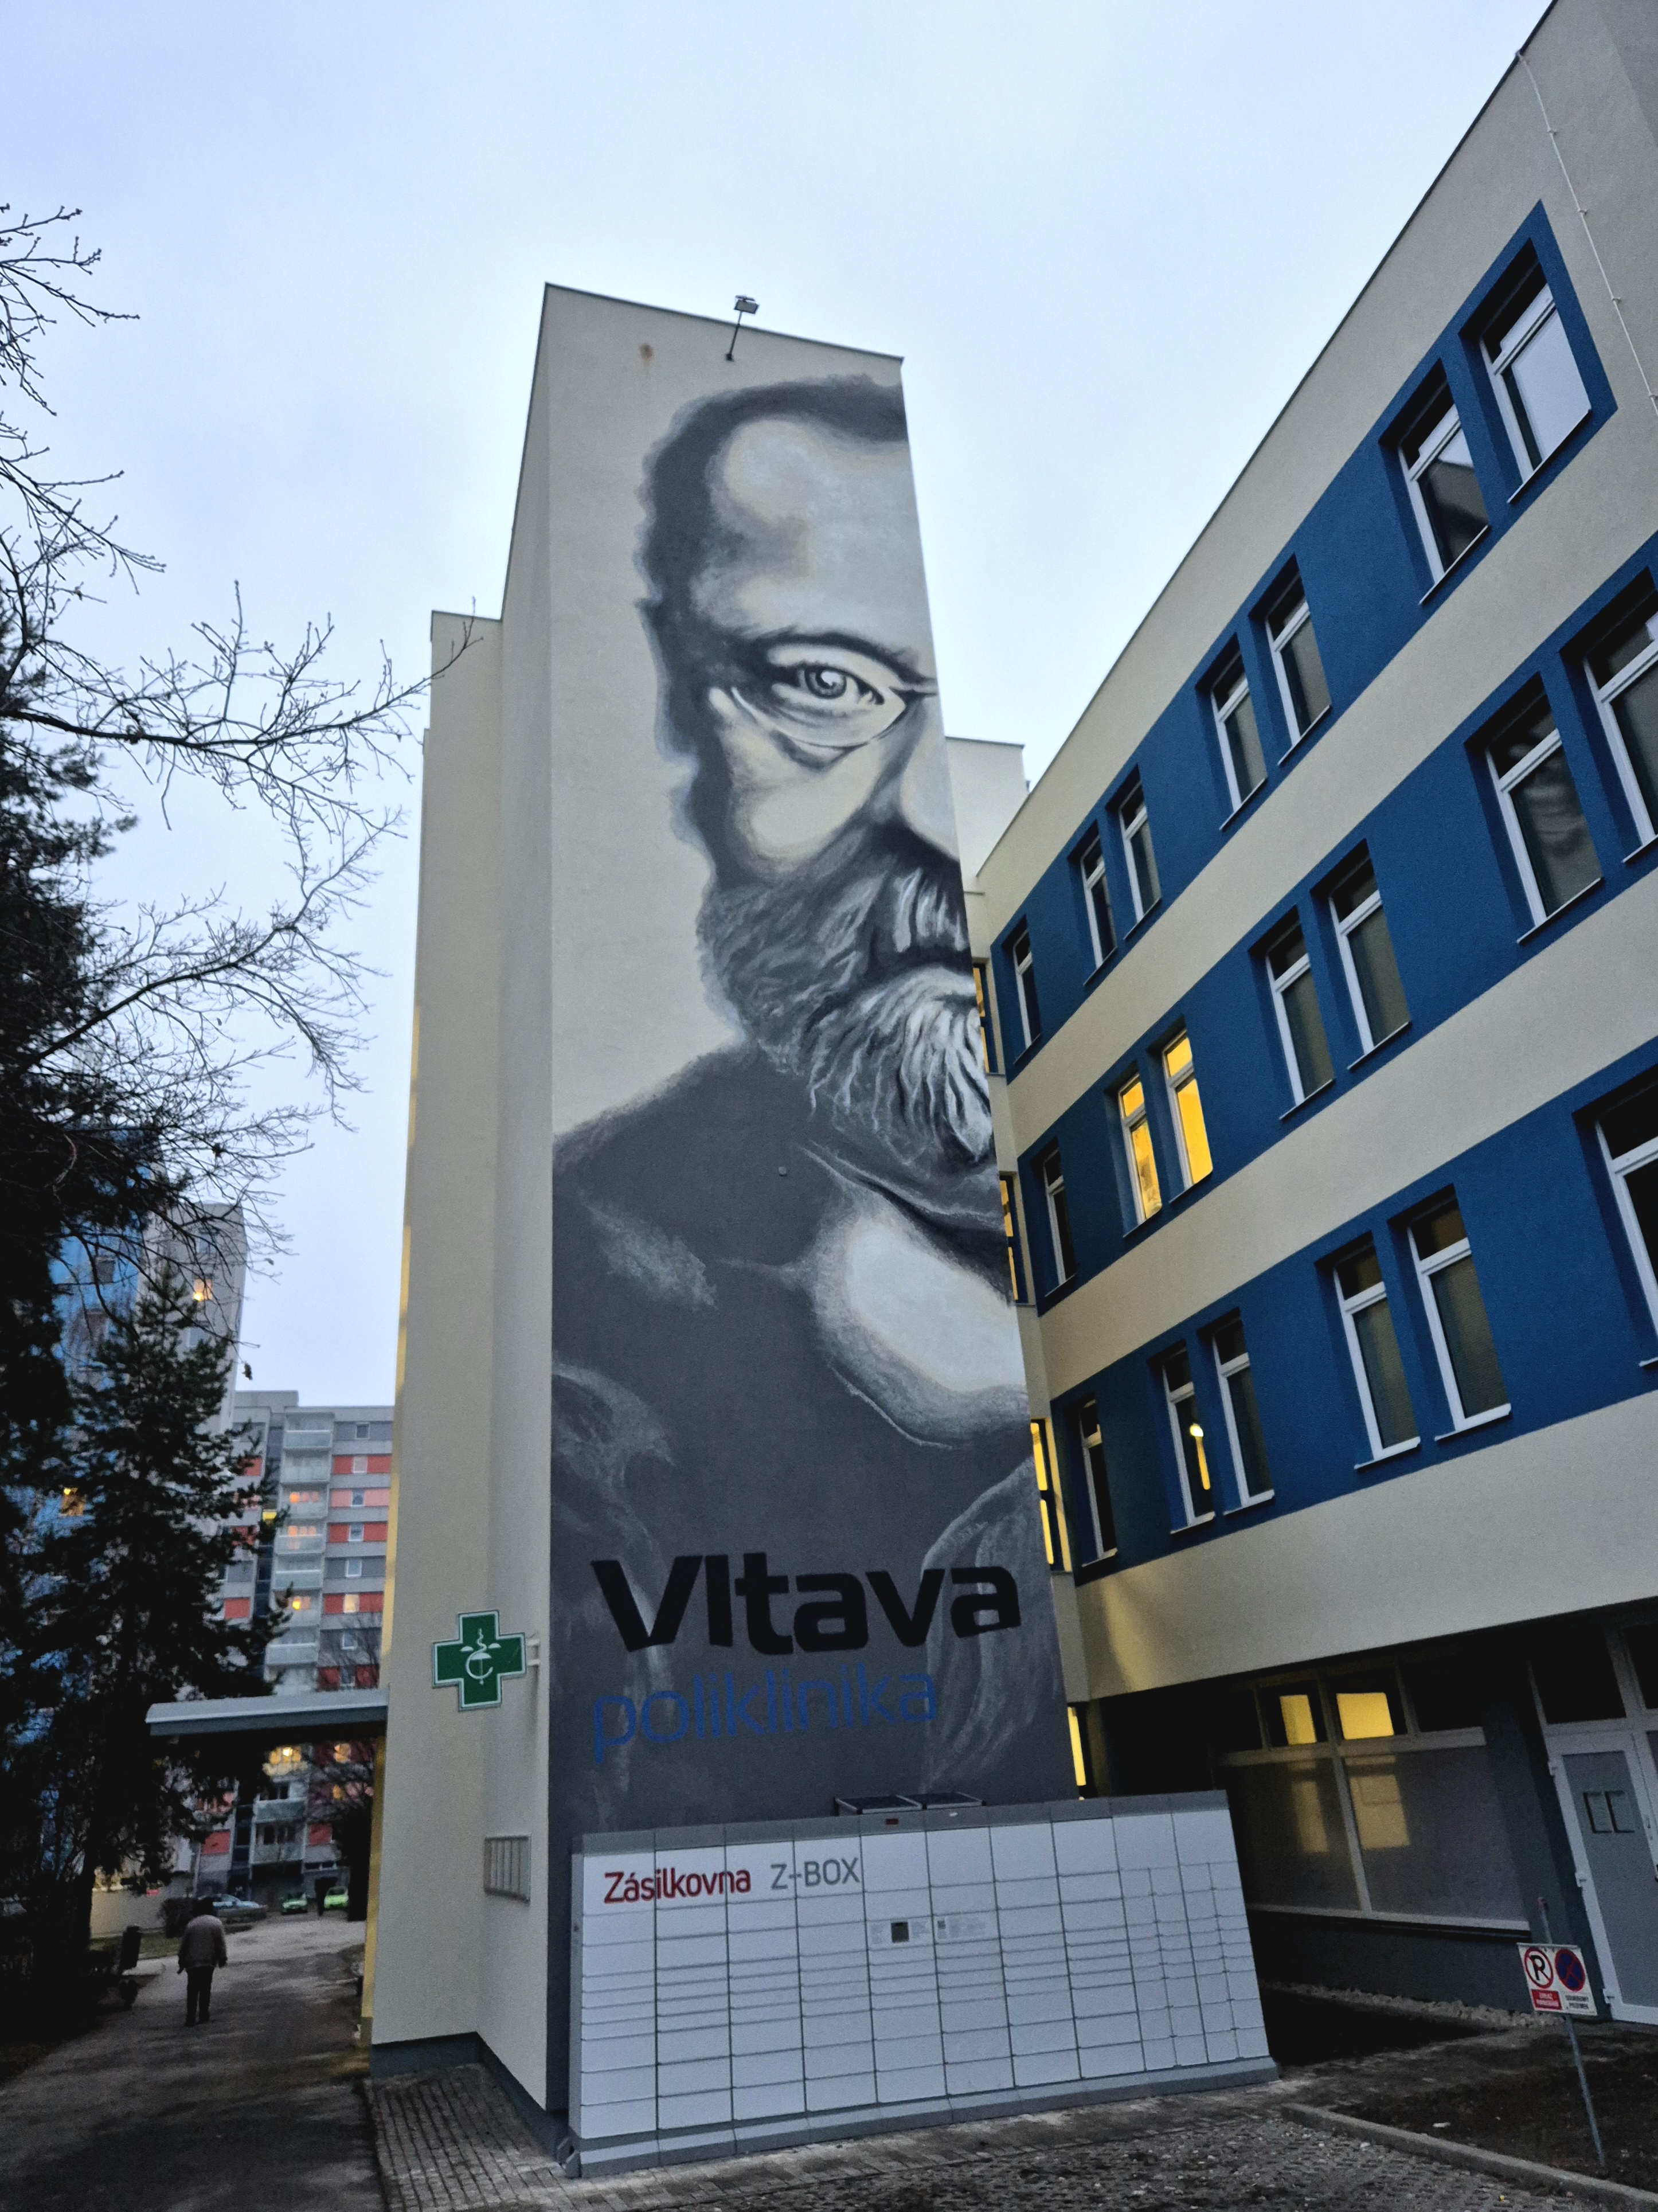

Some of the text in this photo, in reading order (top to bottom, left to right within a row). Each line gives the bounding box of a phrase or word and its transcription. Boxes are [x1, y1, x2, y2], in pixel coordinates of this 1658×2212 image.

[591, 1553, 1022, 1655] Vltava
[593, 1663, 937, 1764] poliklinika
[604, 1857, 859, 1904] Zásilkovna Z-BOX
